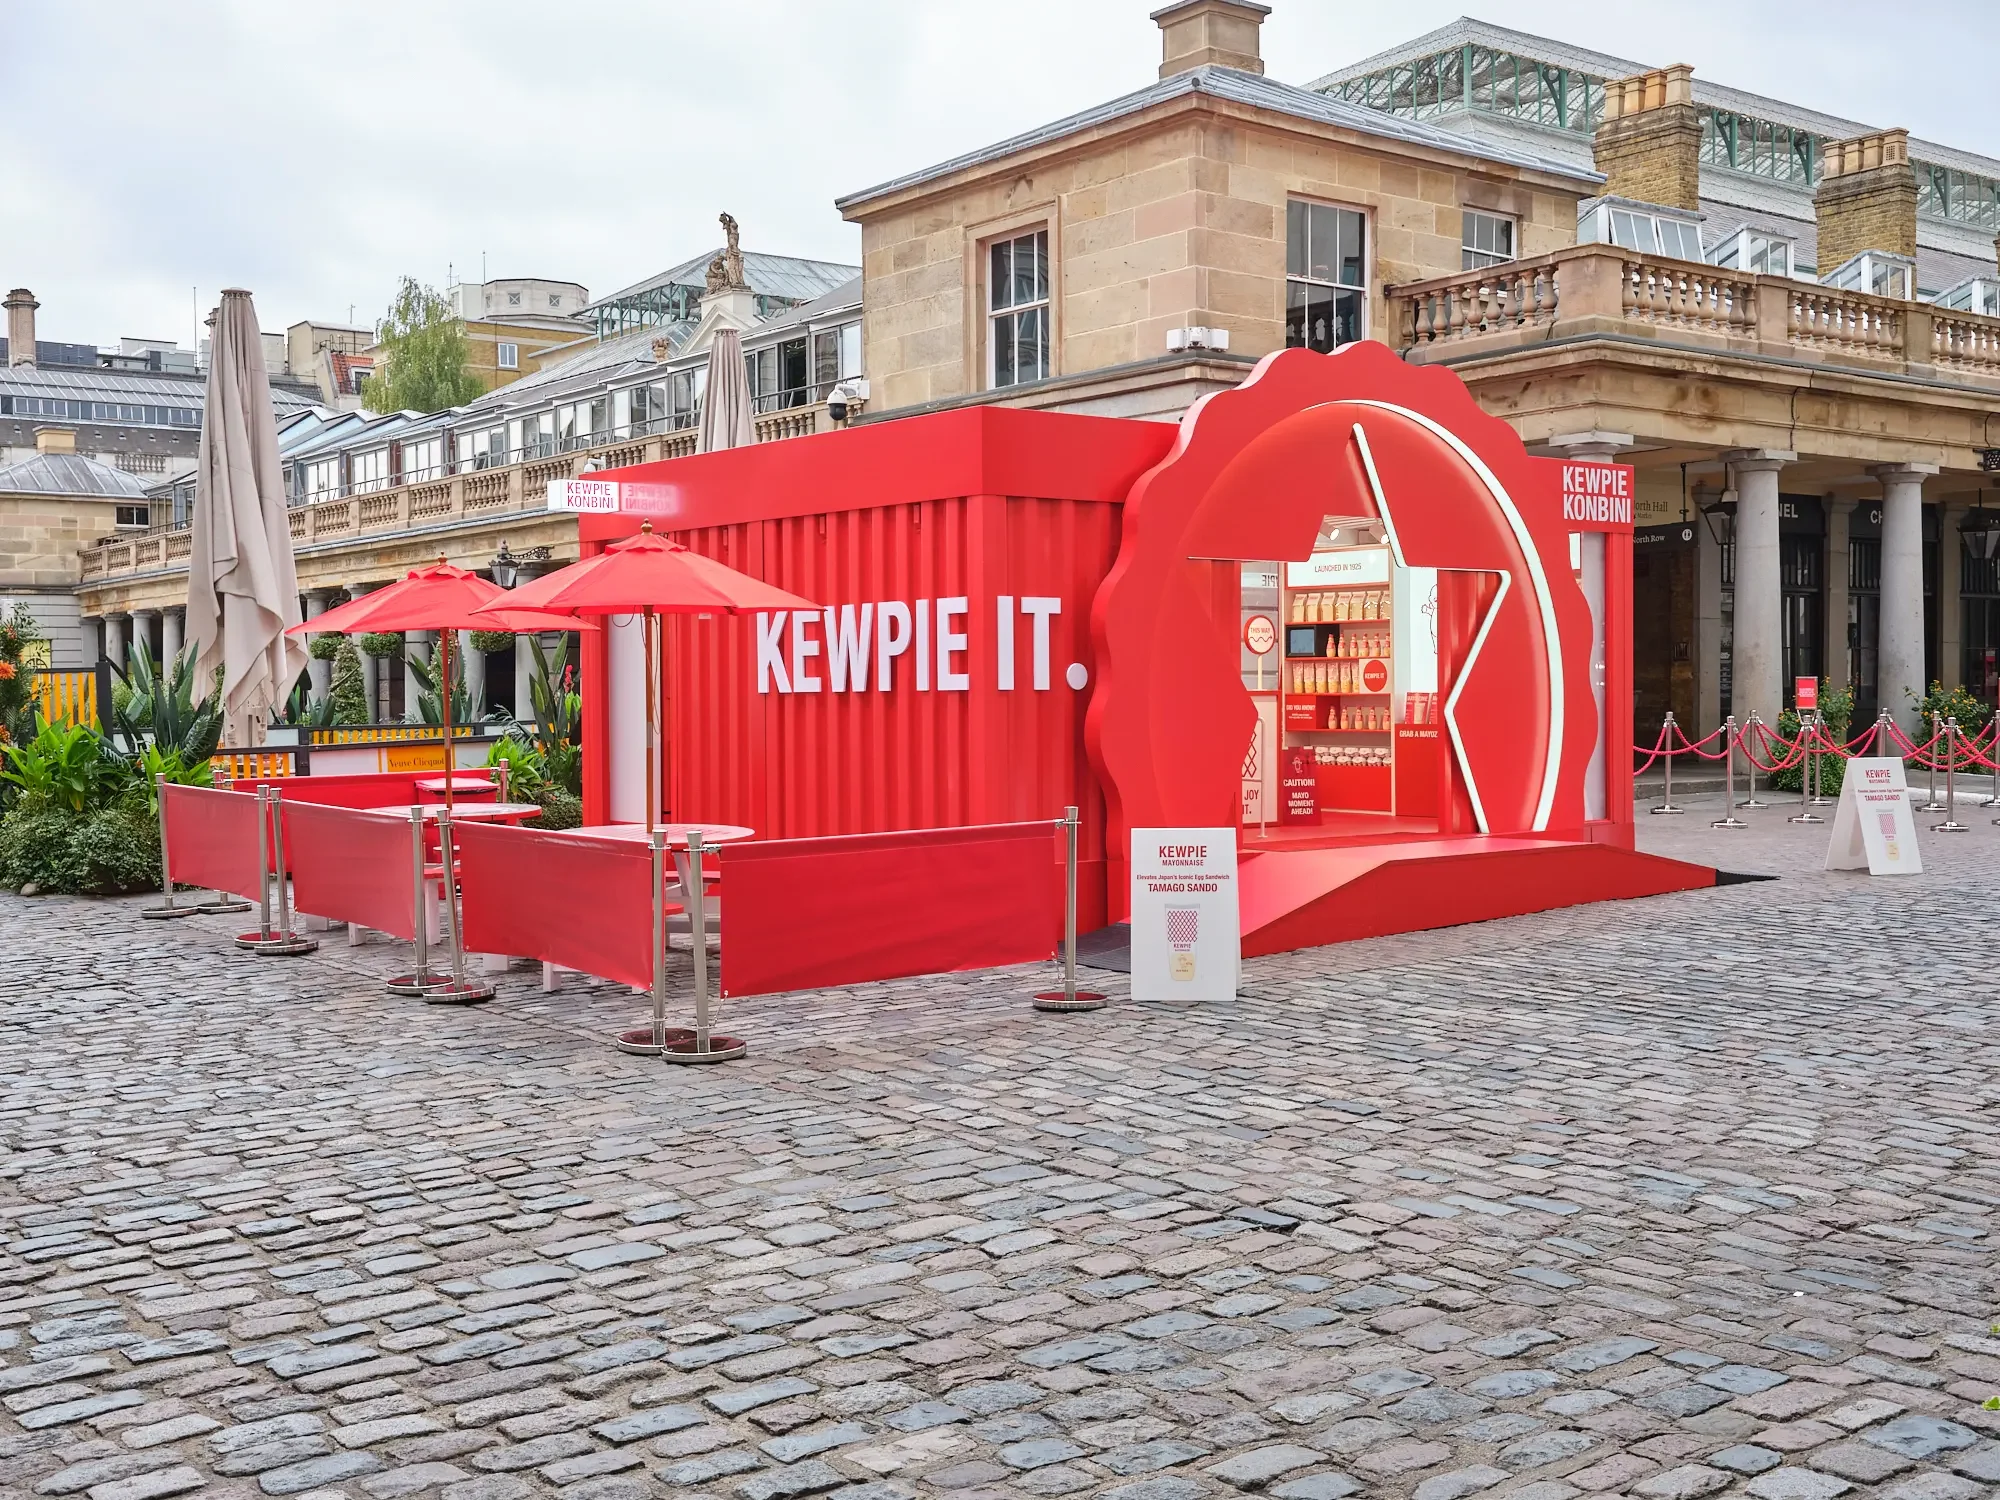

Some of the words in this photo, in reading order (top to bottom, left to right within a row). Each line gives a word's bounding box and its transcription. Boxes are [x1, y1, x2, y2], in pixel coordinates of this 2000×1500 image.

[1563, 465, 1628, 496] KEWPIE
[567, 482, 611, 496] KEWPIE
[567, 495, 614, 509] KONBINI
[1634, 500, 1651, 511] orth
[1652, 501, 1668, 512] Hall
[1563, 494, 1631, 523] KONBINI
[1651, 535, 1666, 543] Row
[1315, 564, 1342, 573] LAUNCHED
[1350, 563, 1362, 571] 1925
[757, 595, 970, 693] KEWPIE
[997, 595, 1089, 691] IT.
[1399, 730, 1414, 738] GRAB
[389, 759, 412, 768] Veuve
[413, 757, 445, 767] Clicquot
[1865, 769, 1891, 778] KEWPIE
[1283, 779, 1316, 787] CAUTION!
[1159, 845, 1207, 858] KEWPIE
[1148, 883, 1185, 893] TAMAGO
[1187, 883, 1218, 893] SANDO
